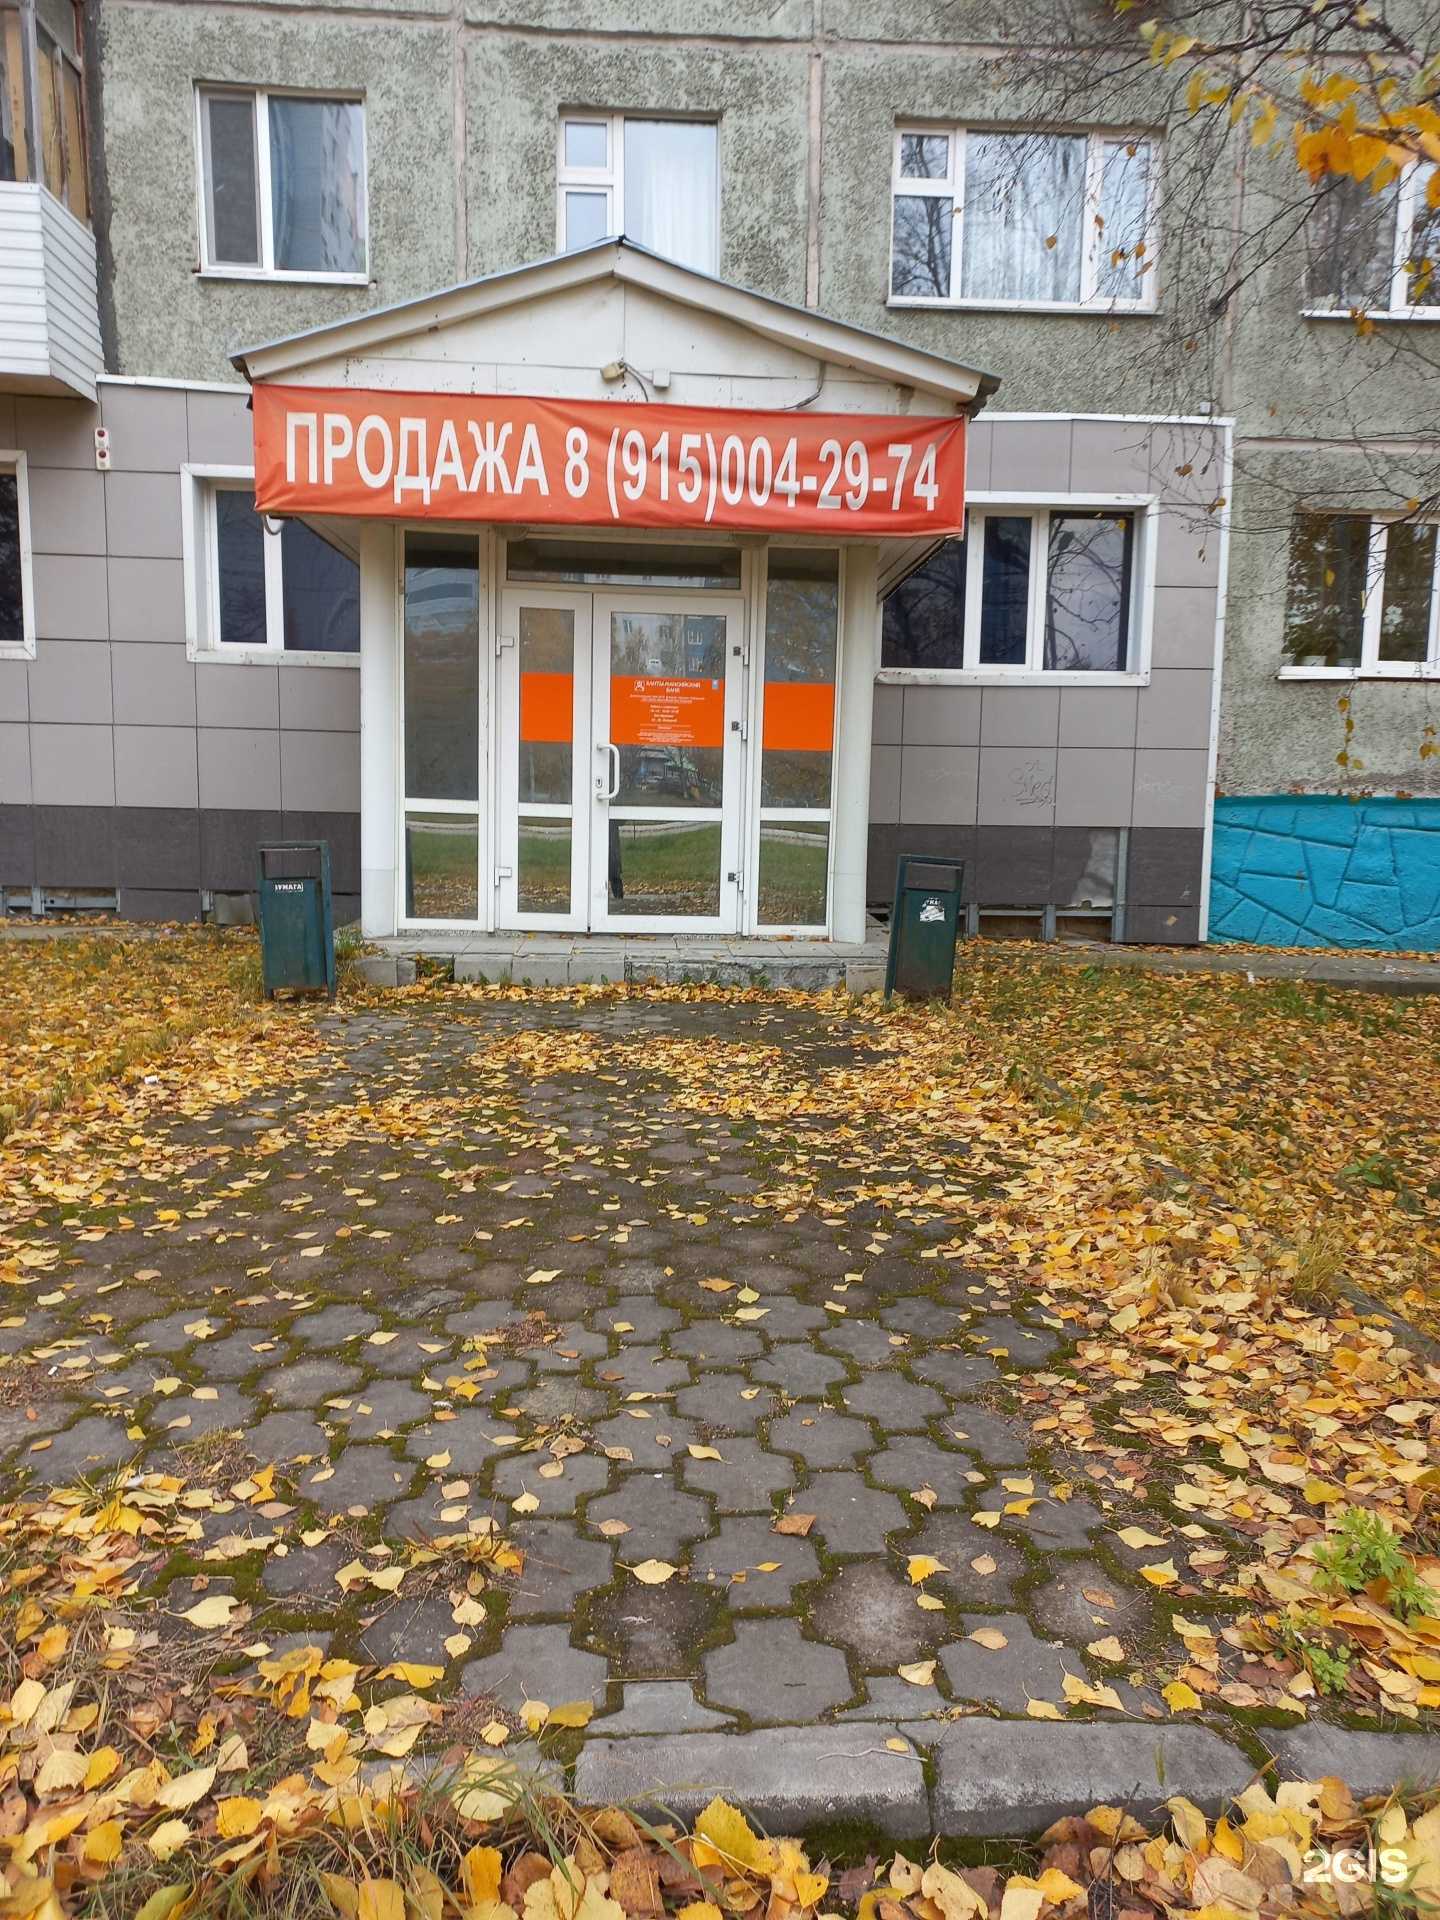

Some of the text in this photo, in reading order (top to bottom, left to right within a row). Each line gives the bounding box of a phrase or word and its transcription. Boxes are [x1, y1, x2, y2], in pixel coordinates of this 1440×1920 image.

[286, 411, 939, 522] ПРОДАЖА 8 (915)004-29-74
